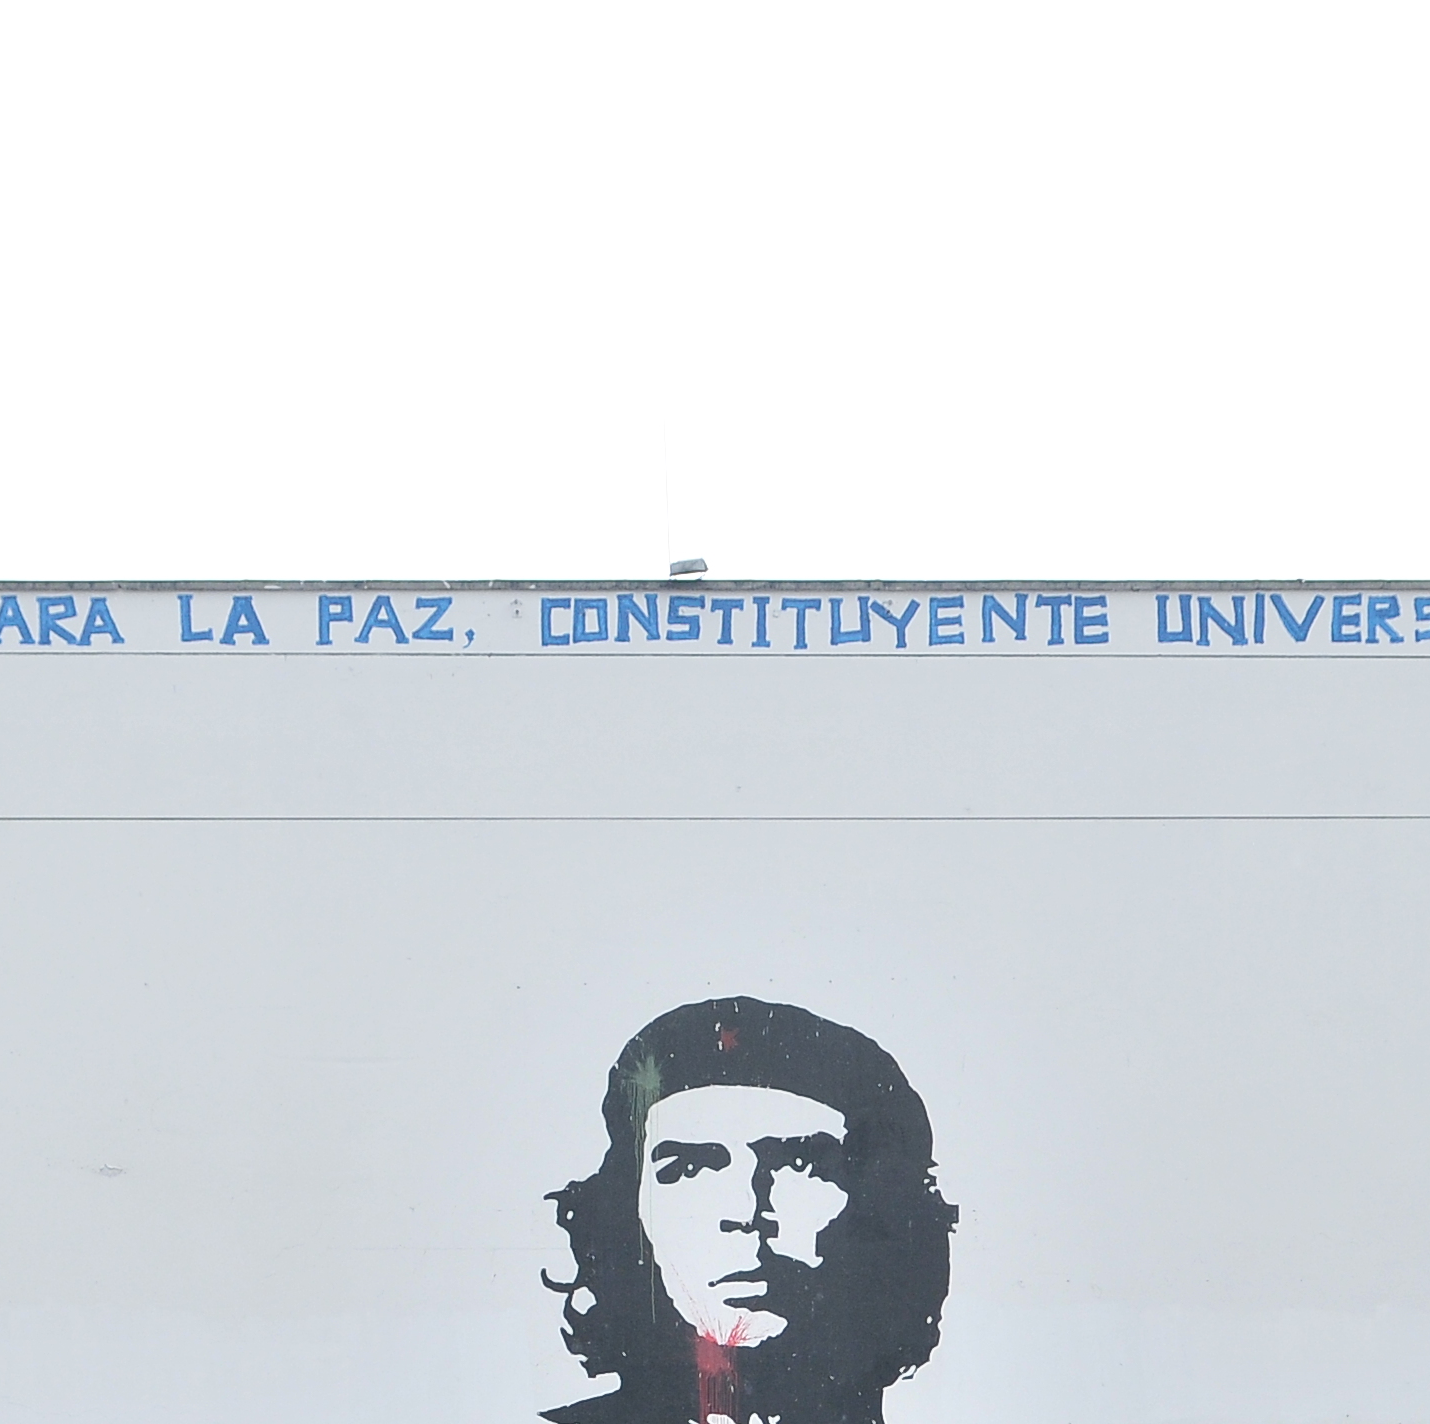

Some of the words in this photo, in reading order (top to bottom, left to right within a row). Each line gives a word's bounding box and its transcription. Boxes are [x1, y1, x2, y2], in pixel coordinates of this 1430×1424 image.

[176, 593, 271, 647] LA
[314, 593, 476, 649] PAZ,
[540, 592, 1111, 650] CONSTITUYENTE
